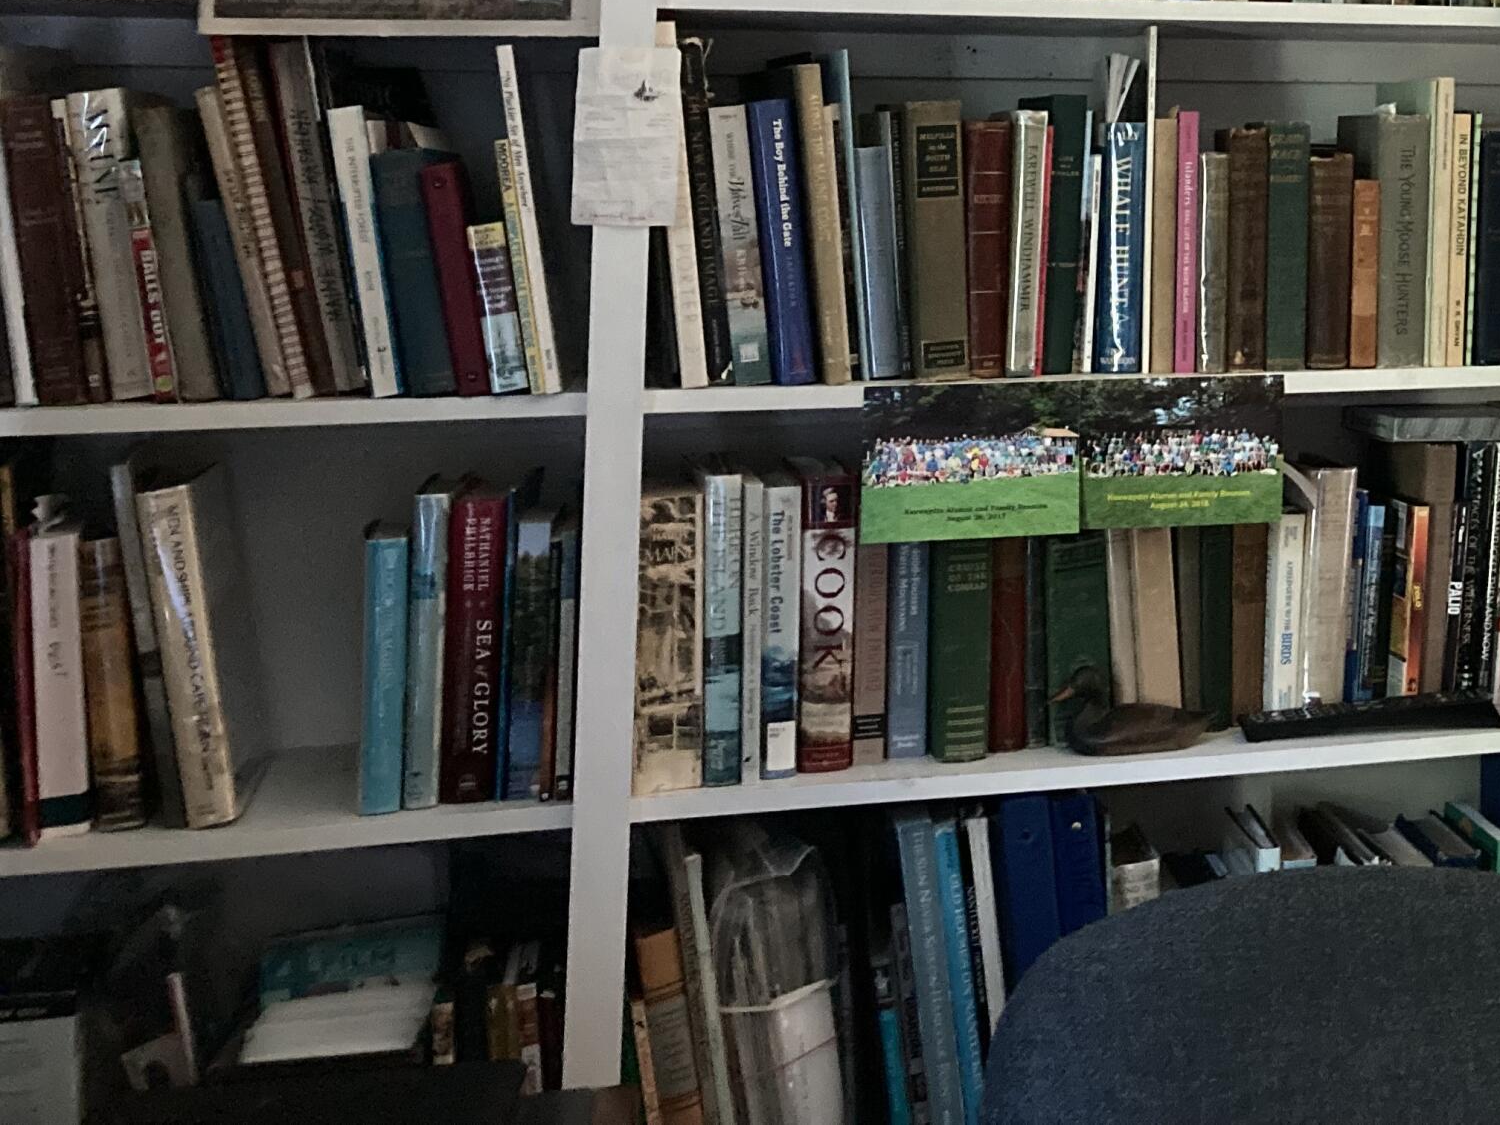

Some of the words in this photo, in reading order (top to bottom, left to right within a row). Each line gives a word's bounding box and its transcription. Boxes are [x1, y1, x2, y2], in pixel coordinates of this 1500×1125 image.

[772, 118, 783, 139] The
[1459, 133, 1468, 144] IN
[495, 142, 512, 192] MOOREA
[772, 141, 786, 161] Boy
[1398, 145, 1416, 169] THE
[1457, 149, 1467, 194] BEYOND
[775, 163, 790, 201] Behind
[1023, 144, 1038, 210] FAREWELL
[1114, 155, 1131, 234] WHALE
[1183, 161, 1194, 205] Islanders
[1396, 173, 1415, 218] YOUNG
[355, 212, 369, 244] FOREST
[694, 171, 713, 250] ENGLAND
[780, 203, 792, 219] the
[1454, 198, 1465, 256] KATAHDIN
[781, 222, 794, 247] Gate
[1395, 220, 1413, 268] MOOSE
[1018, 216, 1035, 312] WINDJAMMER
[1113, 244, 1129, 306] HUNT
[1393, 272, 1412, 335] HUNTERS
[149, 308, 165, 345] OUT
[165, 504, 181, 535] MEN
[749, 511, 759, 521] A
[772, 509, 785, 534] The
[170, 540, 186, 571] AND
[463, 517, 476, 590] PHILBRICK
[477, 517, 490, 590] NATHANIEL
[748, 531, 759, 579] Window
[769, 539, 784, 591] Lobster
[769, 595, 783, 633] Coast
[813, 533, 847, 672] COOK
[1446, 580, 1462, 615] PALIO
[1459, 579, 1475, 644] WILDERNESS
[474, 619, 491, 660] SEA
[1279, 631, 1293, 665] BIRDS
[1480, 632, 1490, 660] NOW
[472, 682, 489, 754] GLORY
